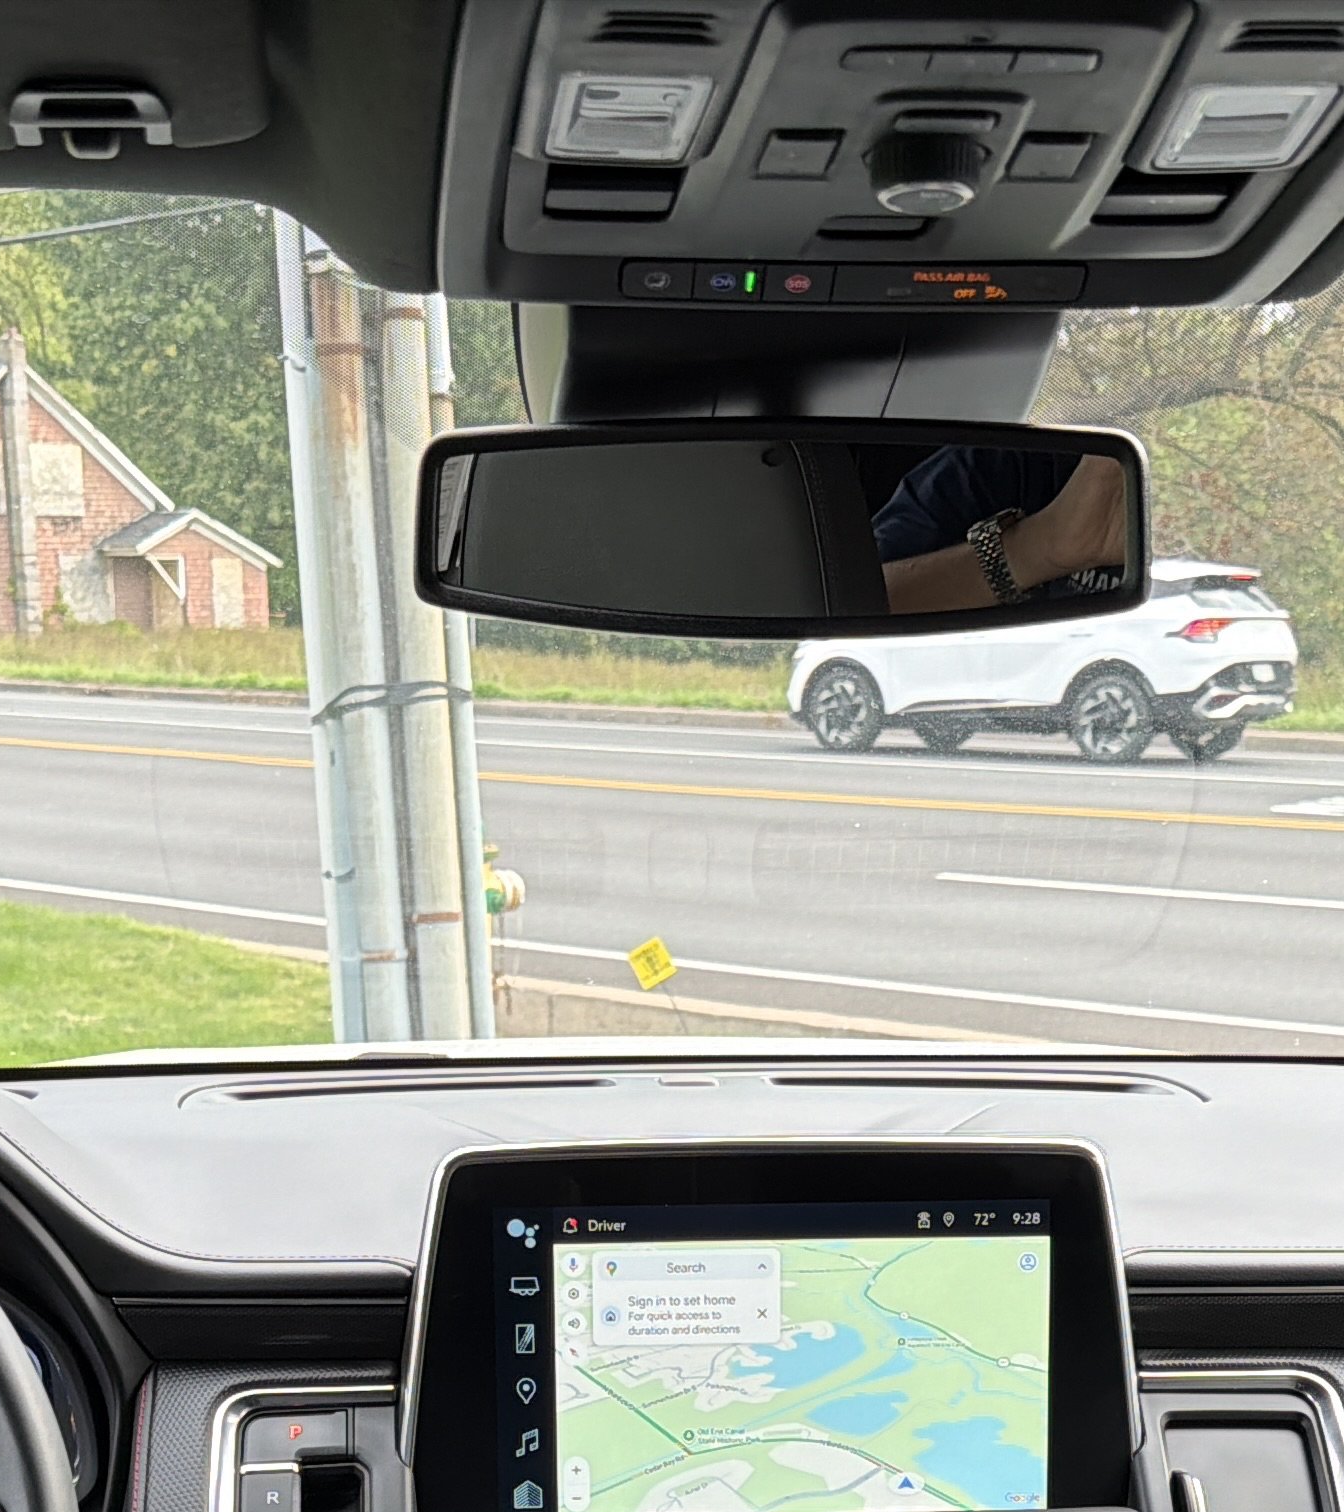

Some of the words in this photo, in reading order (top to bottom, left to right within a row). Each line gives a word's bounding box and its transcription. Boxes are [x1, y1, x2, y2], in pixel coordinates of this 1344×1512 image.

[914, 272, 943, 282] PASS
[789, 280, 808, 288] SOS
[954, 288, 976, 298] OFF
[974, 1213, 996, 1225] 72°
[1012, 1212, 1041, 1224] 9:28
[588, 1219, 626, 1232] Driver
[666, 1262, 706, 1274] Search
[628, 1295, 653, 1309] Sign
[656, 1295, 667, 1306] in
[669, 1295, 681, 1306] to
[683, 1295, 701, 1306] set
[704, 1294, 736, 1306] home
[628, 1312, 644, 1321] For
[647, 1311, 673, 1323] quick
[675, 1312, 709, 1321] access
[712, 1311, 722, 1320] to
[628, 1325, 669, 1335] duration
[671, 1325, 690, 1335] and
[692, 1324, 741, 1335] directions
[289, 1425, 303, 1440] P
[266, 1491, 280, 1505] R
[1005, 1492, 1040, 1503] Google
